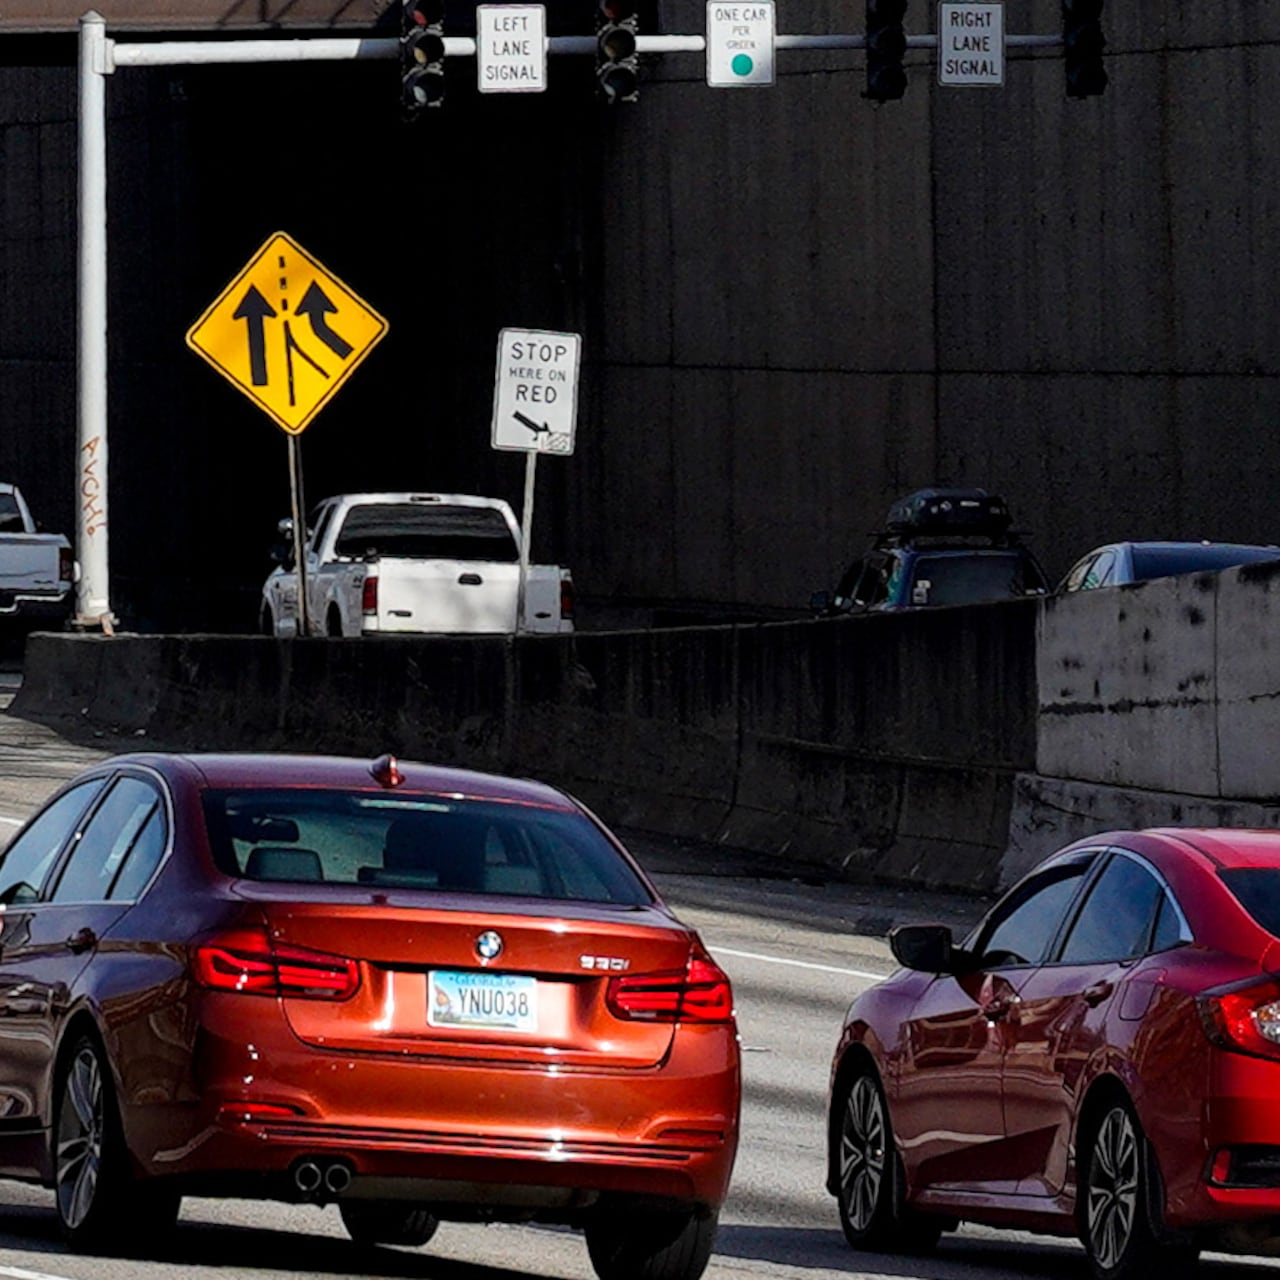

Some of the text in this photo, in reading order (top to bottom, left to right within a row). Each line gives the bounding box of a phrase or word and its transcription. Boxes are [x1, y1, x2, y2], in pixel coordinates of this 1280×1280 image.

[715, 8, 767, 21] ONE CAR
[951, 11, 992, 28] RIGHT
[494, 16, 528, 32] LEFT
[493, 40, 531, 56] LANE
[953, 35, 990, 52] LANE
[485, 64, 539, 81] SIGNAL
[945, 59, 999, 76] SIGNAL
[511, 342, 567, 362] STOP
[509, 367, 566, 382] HERE ON
[515, 384, 557, 404] RED
